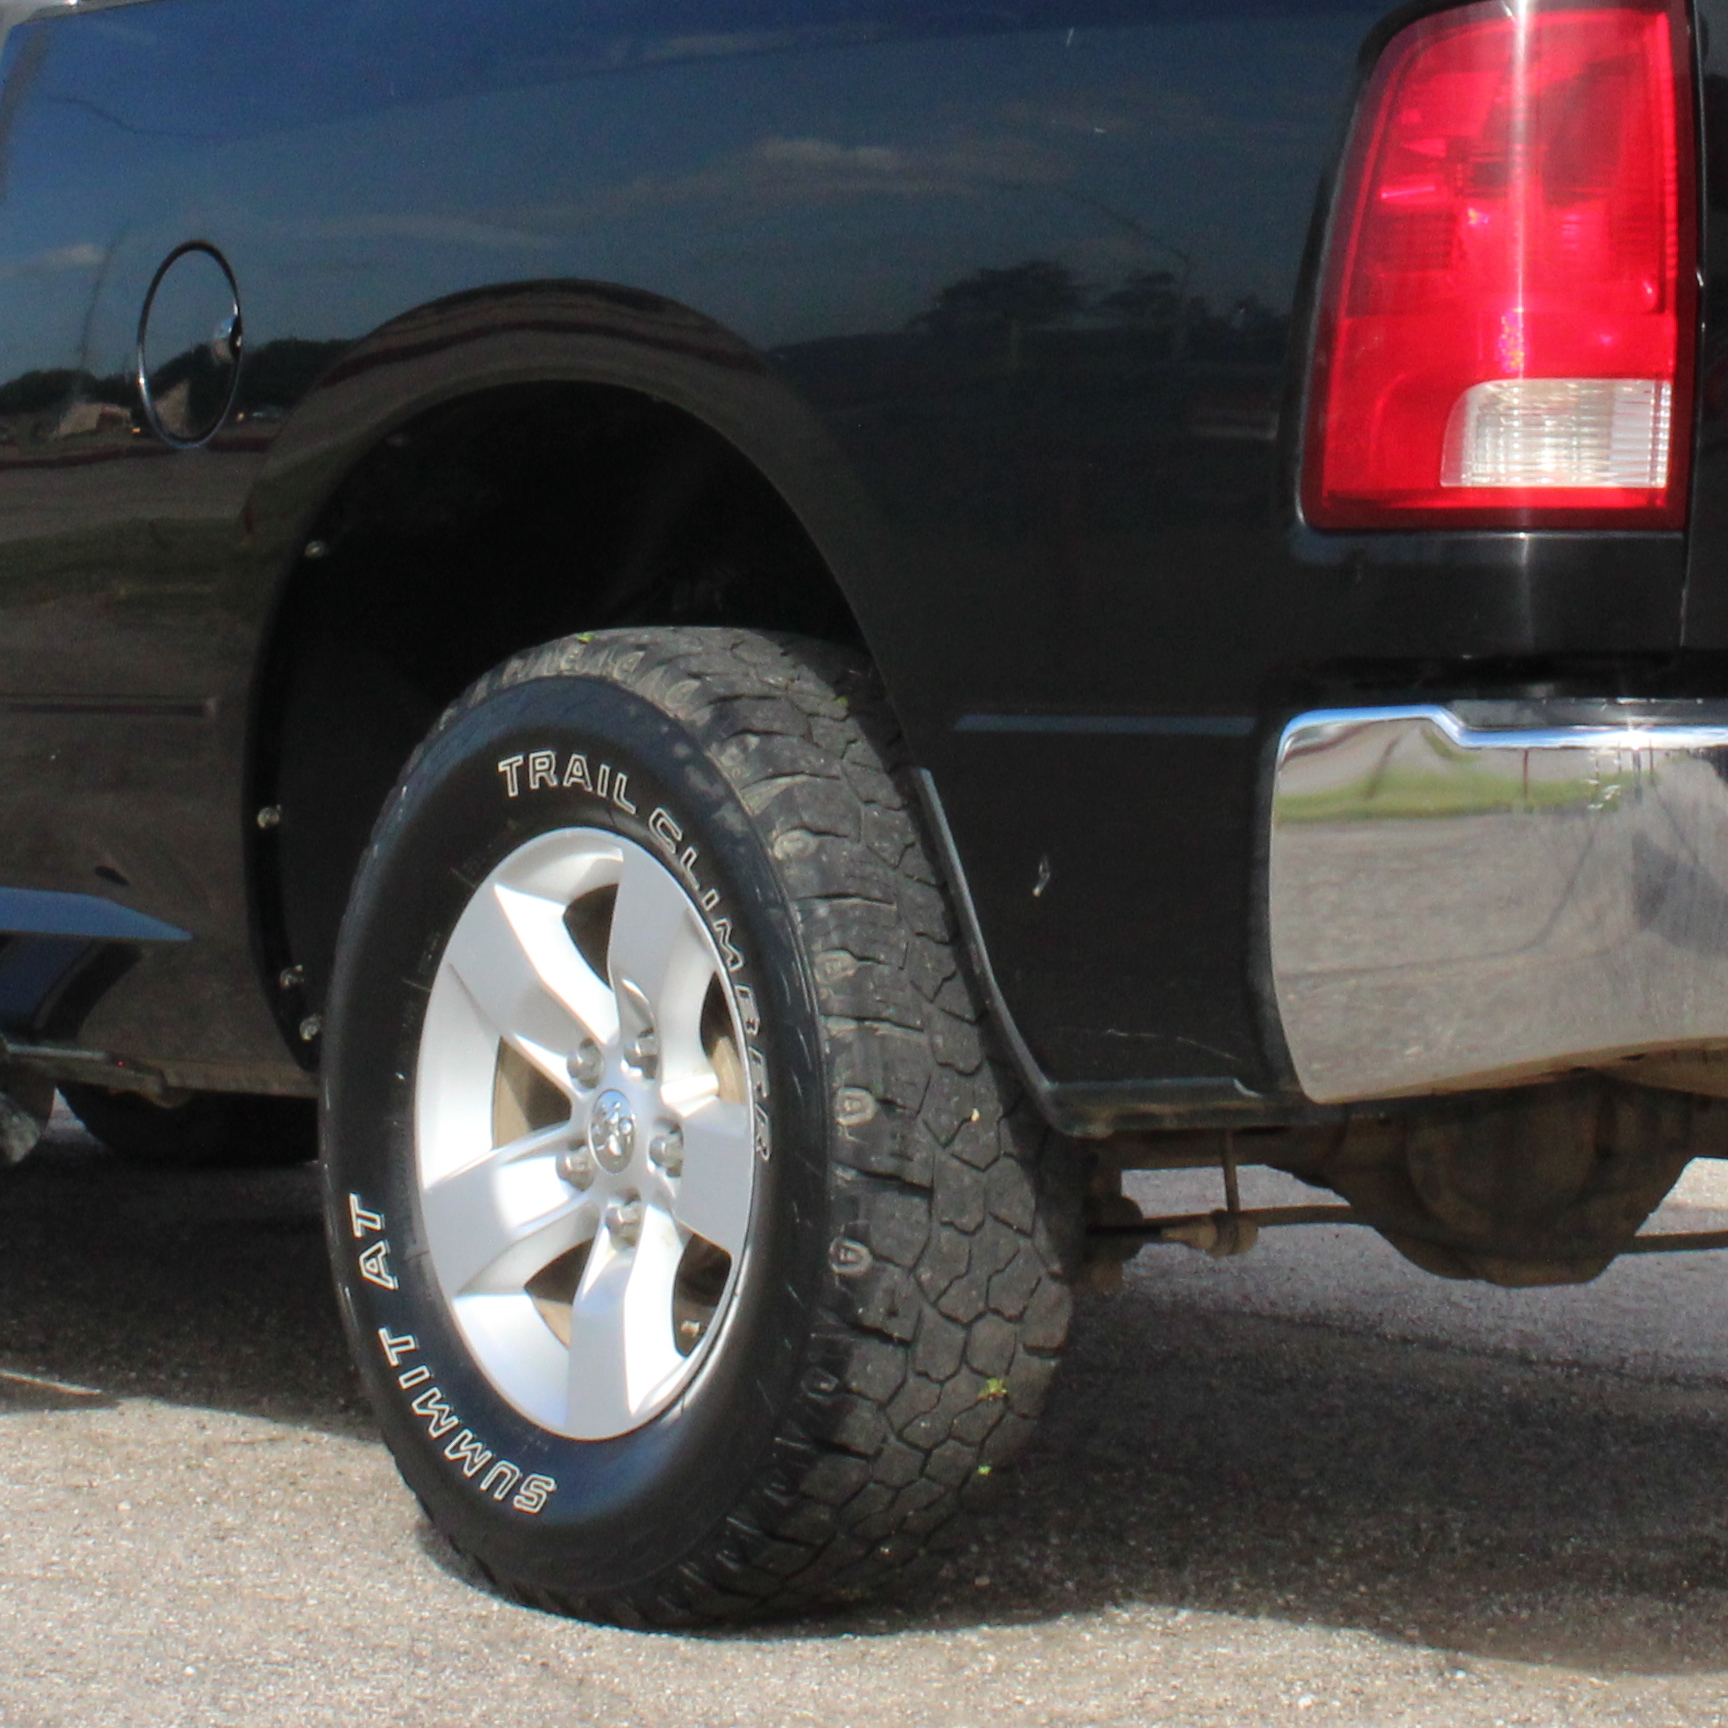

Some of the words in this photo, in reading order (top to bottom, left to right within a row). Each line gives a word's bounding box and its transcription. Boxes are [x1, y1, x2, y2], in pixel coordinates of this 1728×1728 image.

[498, 750, 638, 815] TRAIL
[649, 806, 772, 1162] CLIMBER
[349, 1192, 400, 1291] AT
[378, 1326, 558, 1514] SUMMIT
